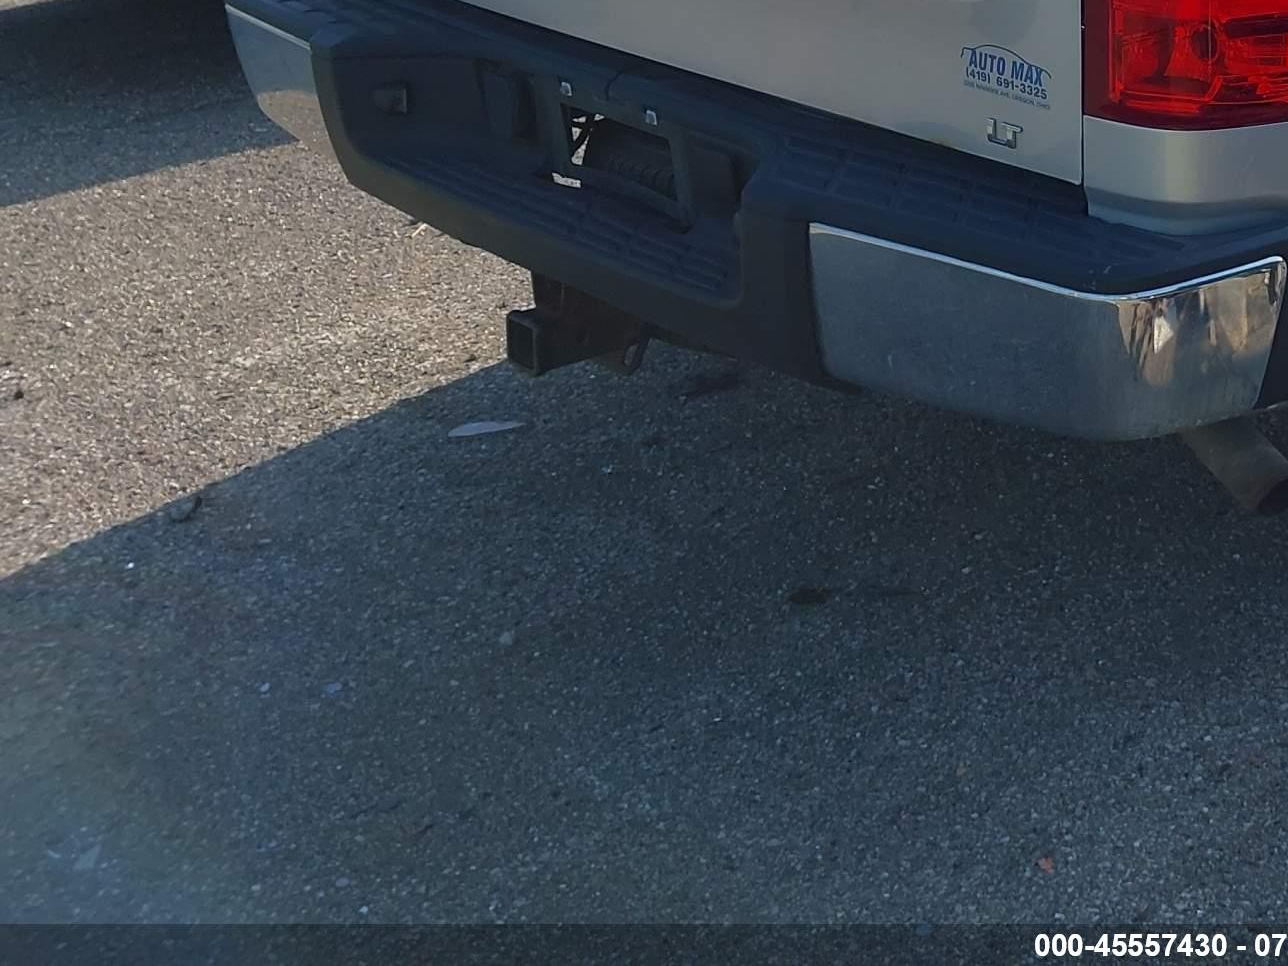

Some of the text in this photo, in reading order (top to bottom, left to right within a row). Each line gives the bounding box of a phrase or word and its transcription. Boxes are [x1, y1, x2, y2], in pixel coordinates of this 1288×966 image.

[965, 67, 990, 84] (419)
[996, 76, 1048, 100] 691-3325
[968, 49, 1044, 87] AUTO MAX
[985, 117, 1024, 149] LT
